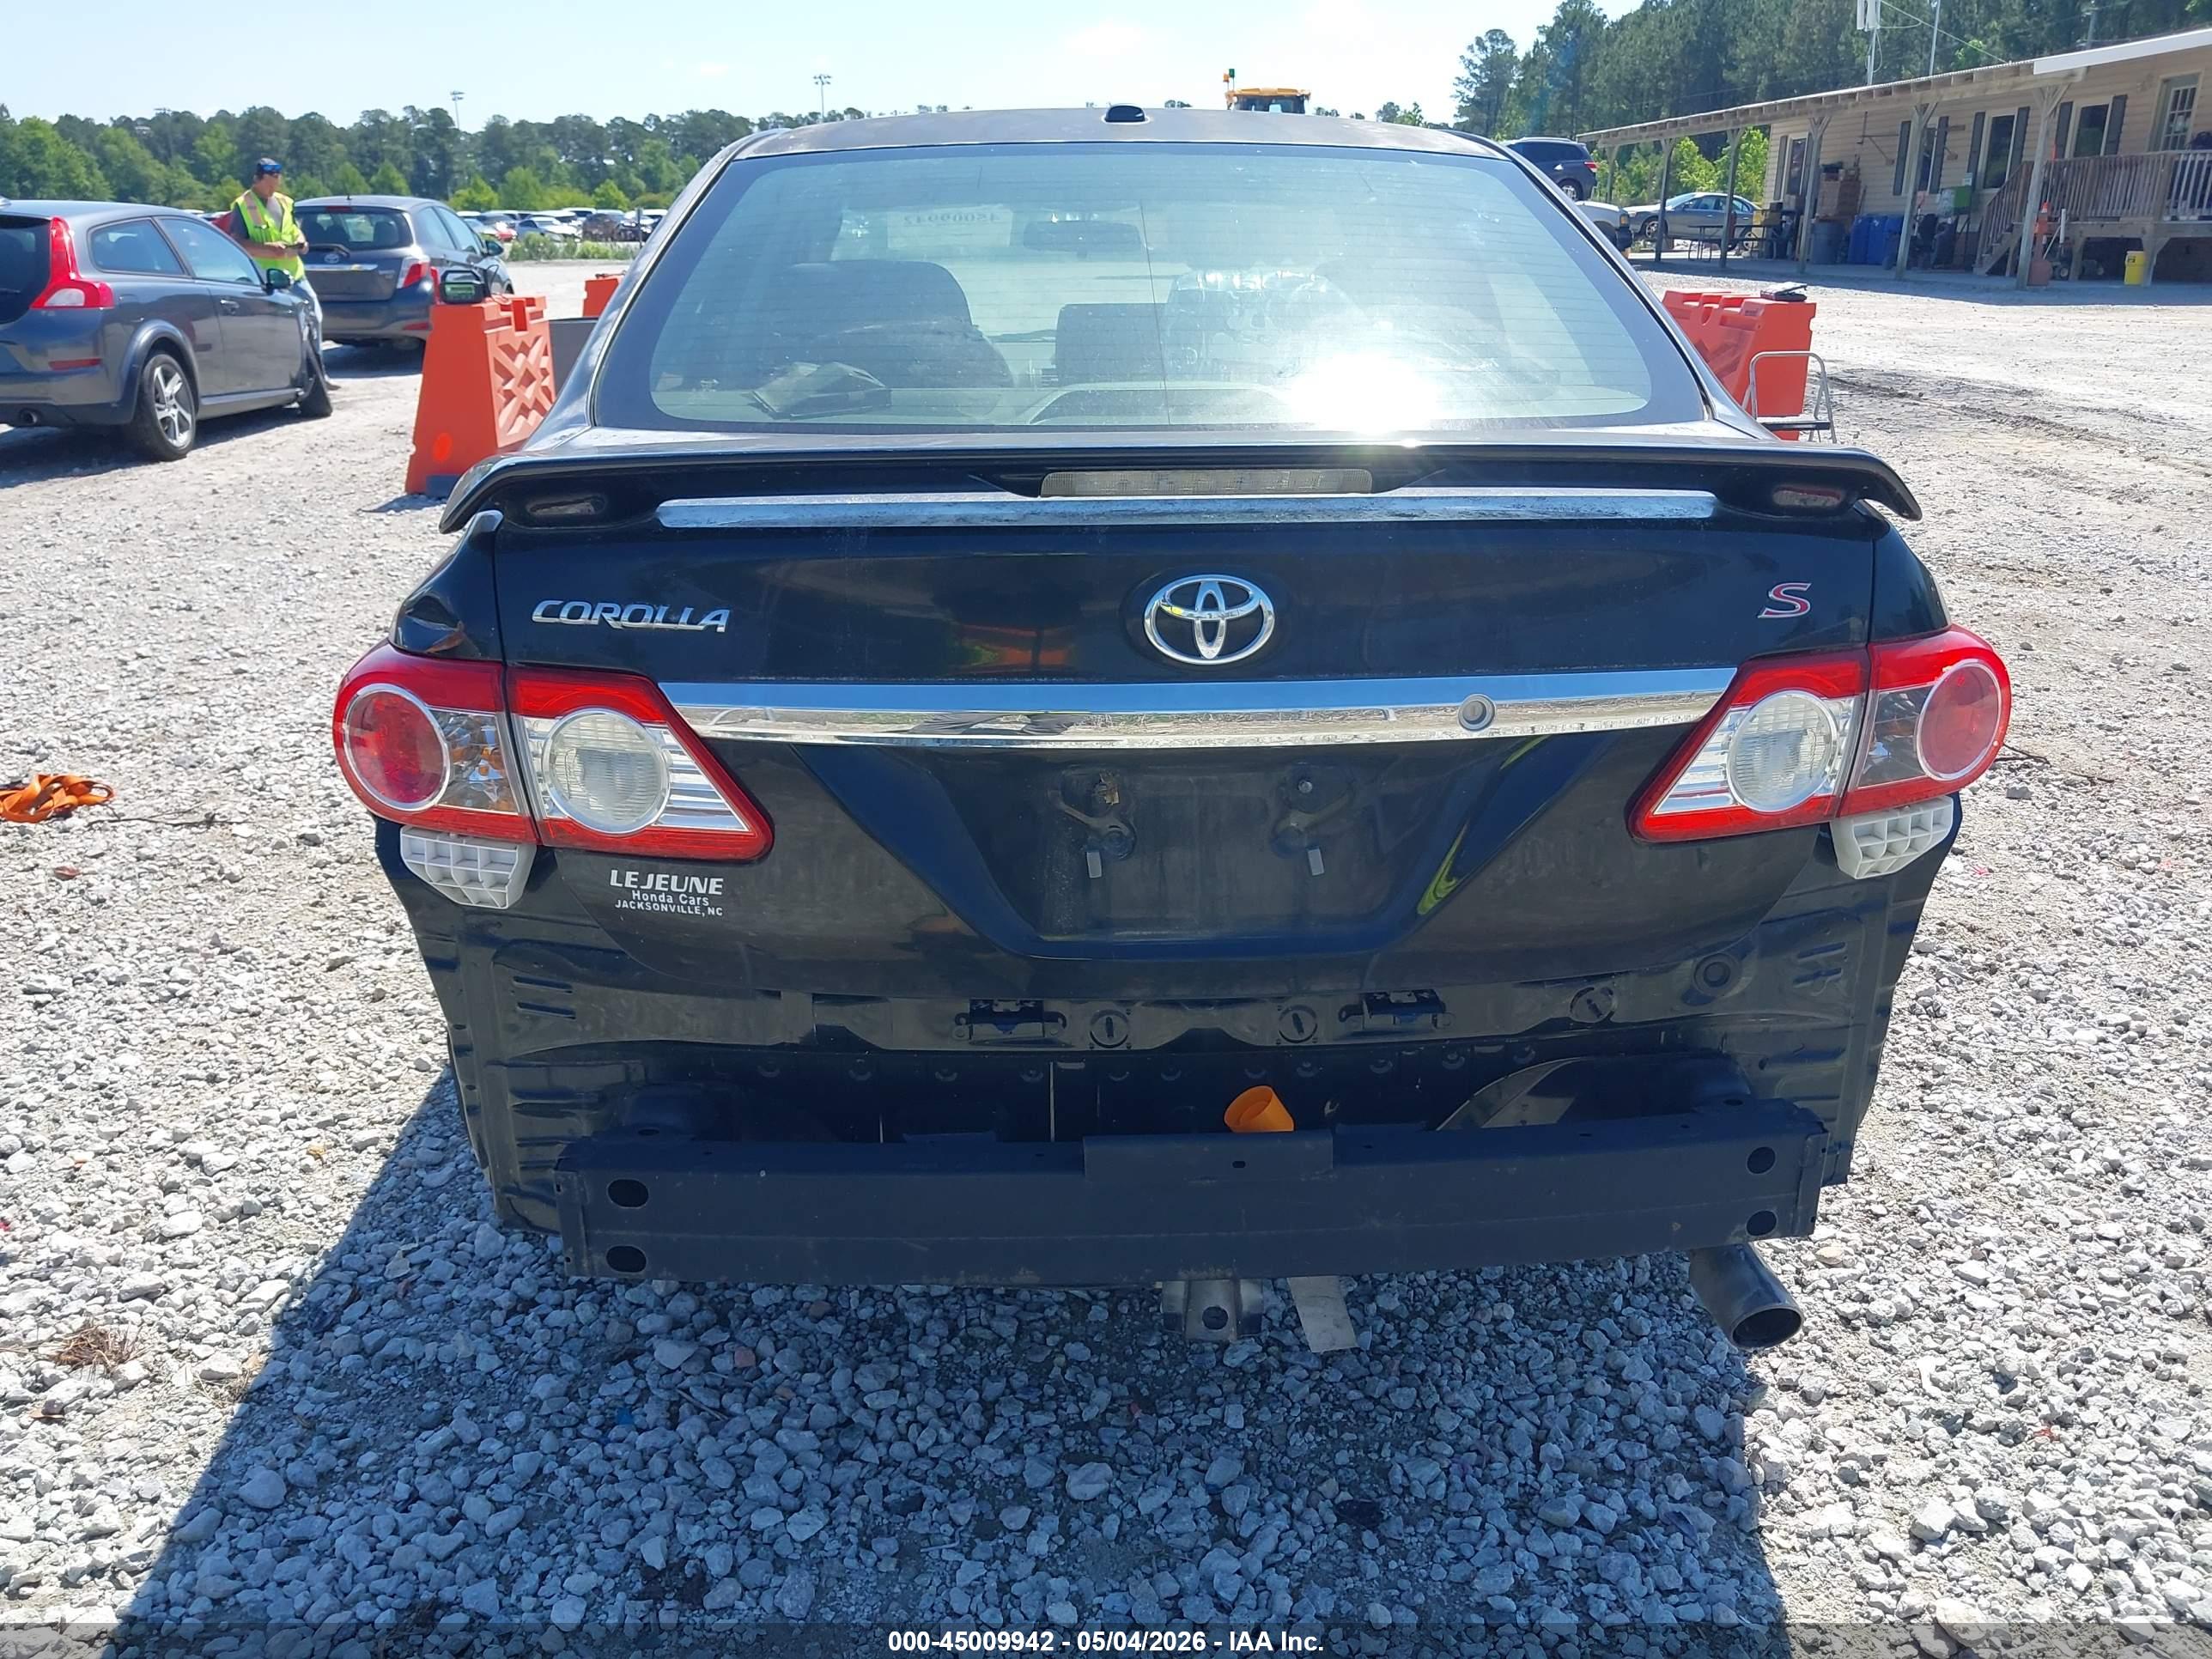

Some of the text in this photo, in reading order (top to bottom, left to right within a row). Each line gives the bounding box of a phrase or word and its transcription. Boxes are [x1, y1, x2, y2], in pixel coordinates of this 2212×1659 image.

[1757, 582, 1812, 618] S
[532, 599, 730, 633] COROLLA
[632, 890, 709, 906] Honda Cars
[707, 907, 723, 916] NC
